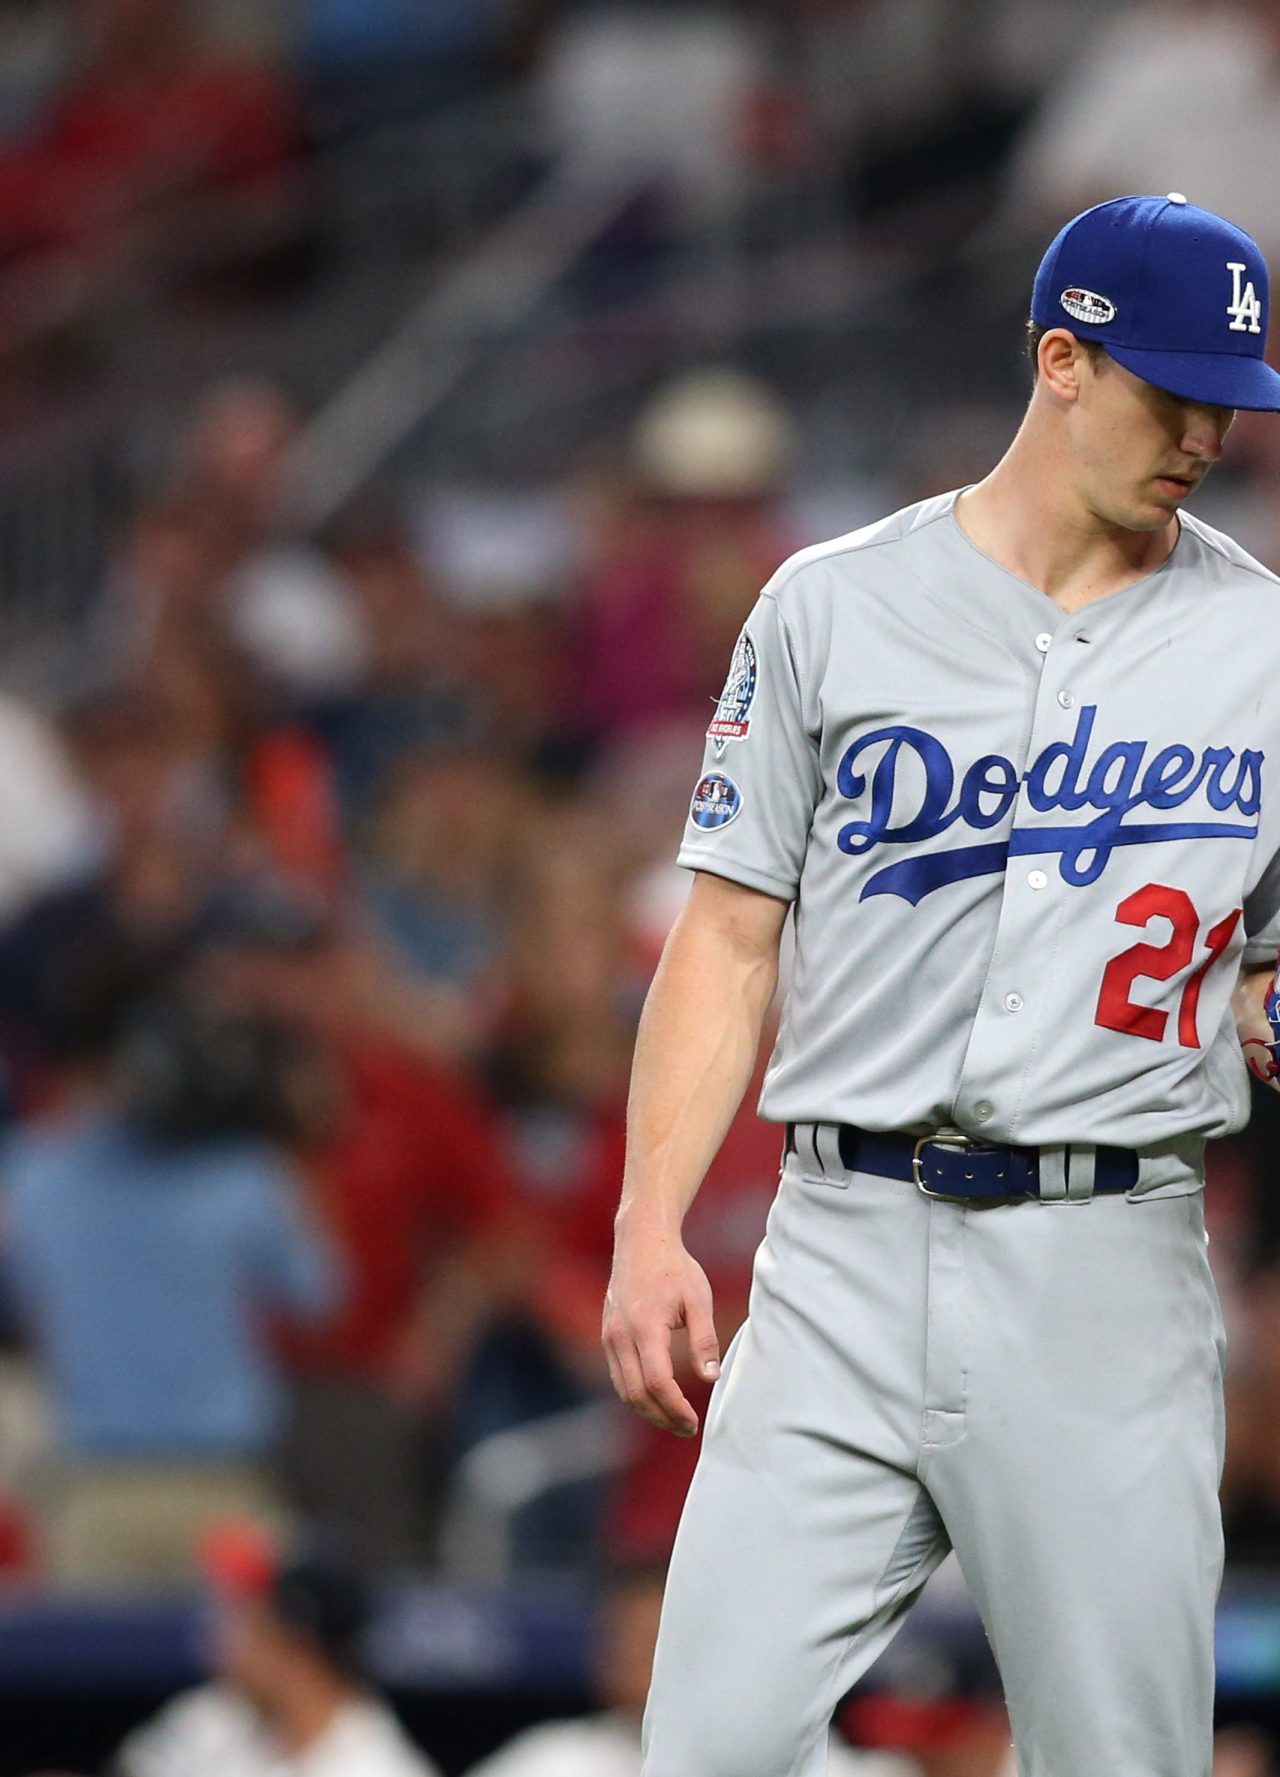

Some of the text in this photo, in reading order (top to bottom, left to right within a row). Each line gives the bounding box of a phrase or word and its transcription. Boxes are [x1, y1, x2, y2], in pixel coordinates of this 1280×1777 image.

[1226, 262, 1261, 333] LA
[837, 705, 1264, 887] Dodgers
[1095, 883, 1243, 1049] 21
